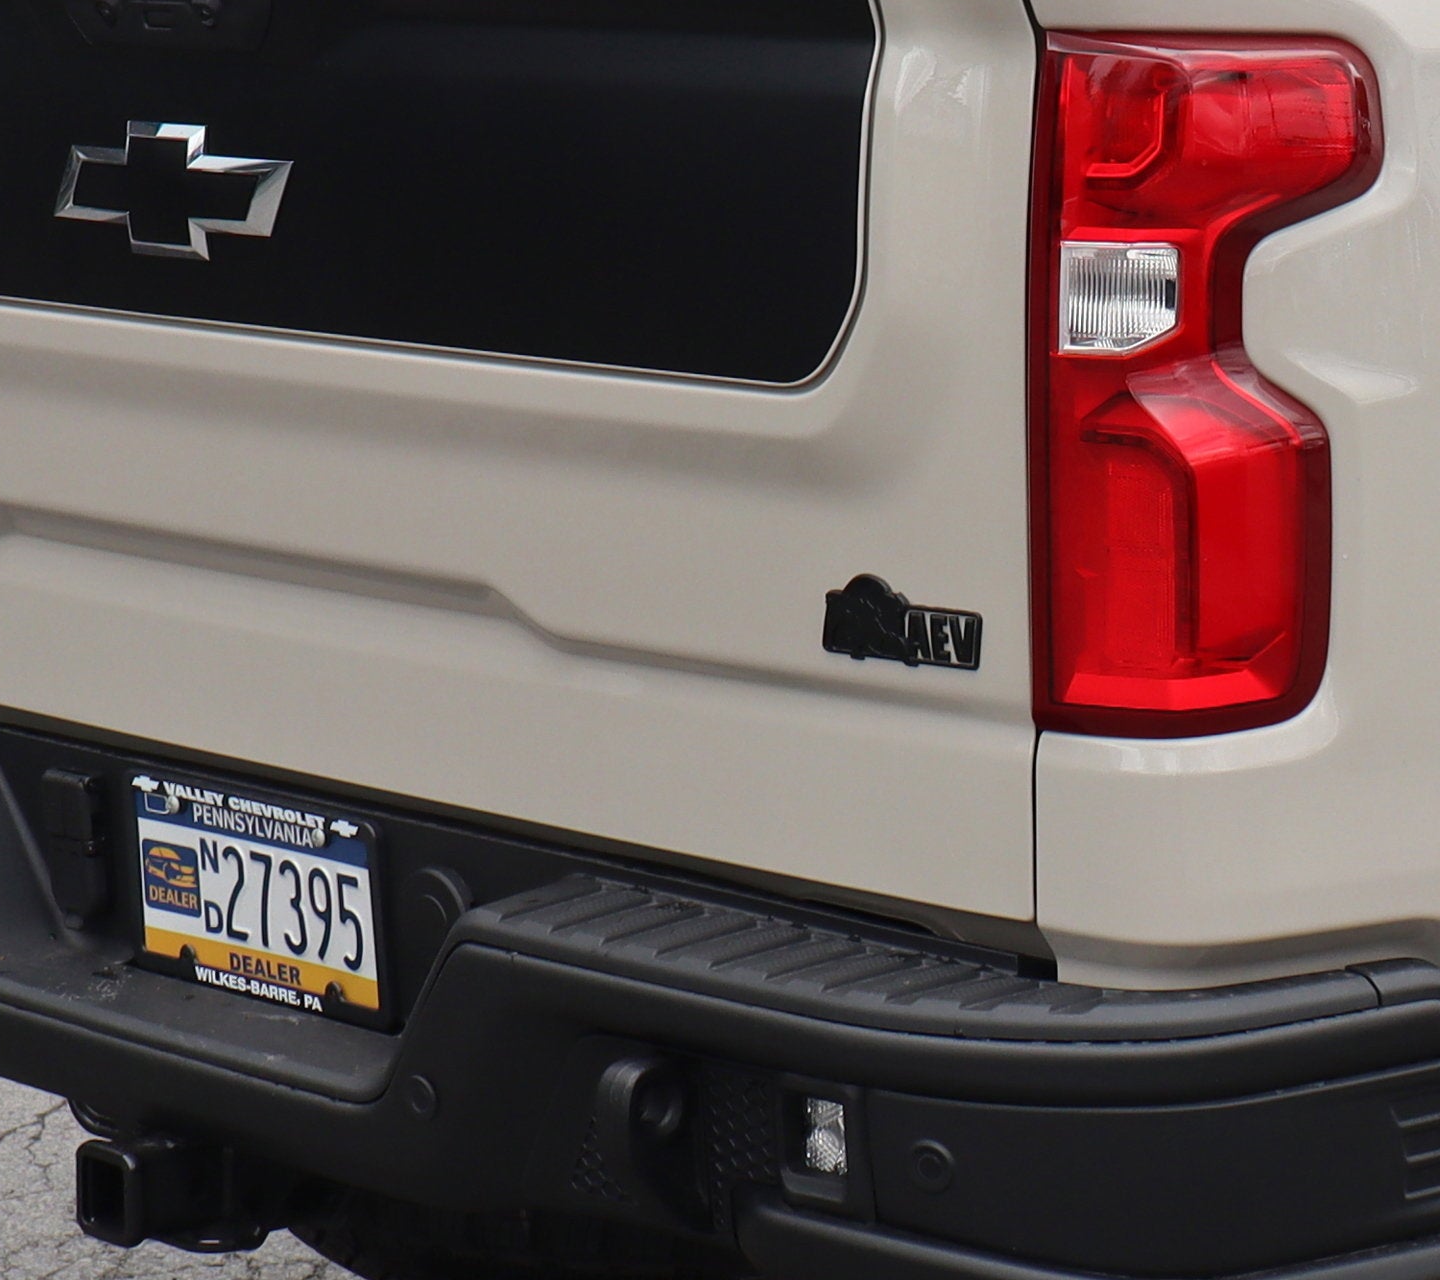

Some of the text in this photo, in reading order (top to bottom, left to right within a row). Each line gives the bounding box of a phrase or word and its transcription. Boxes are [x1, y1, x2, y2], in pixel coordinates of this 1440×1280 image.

[905, 610, 977, 664] AEV
[162, 780, 327, 831] VALLEY CHEVROLET
[193, 802, 315, 849] PENNSYLVANIA
[149, 884, 199, 911] DEALER
[221, 845, 365, 973] 27395
[194, 965, 323, 1013] WILKES-BARRE, PA
[228, 951, 302, 986] DEALER
